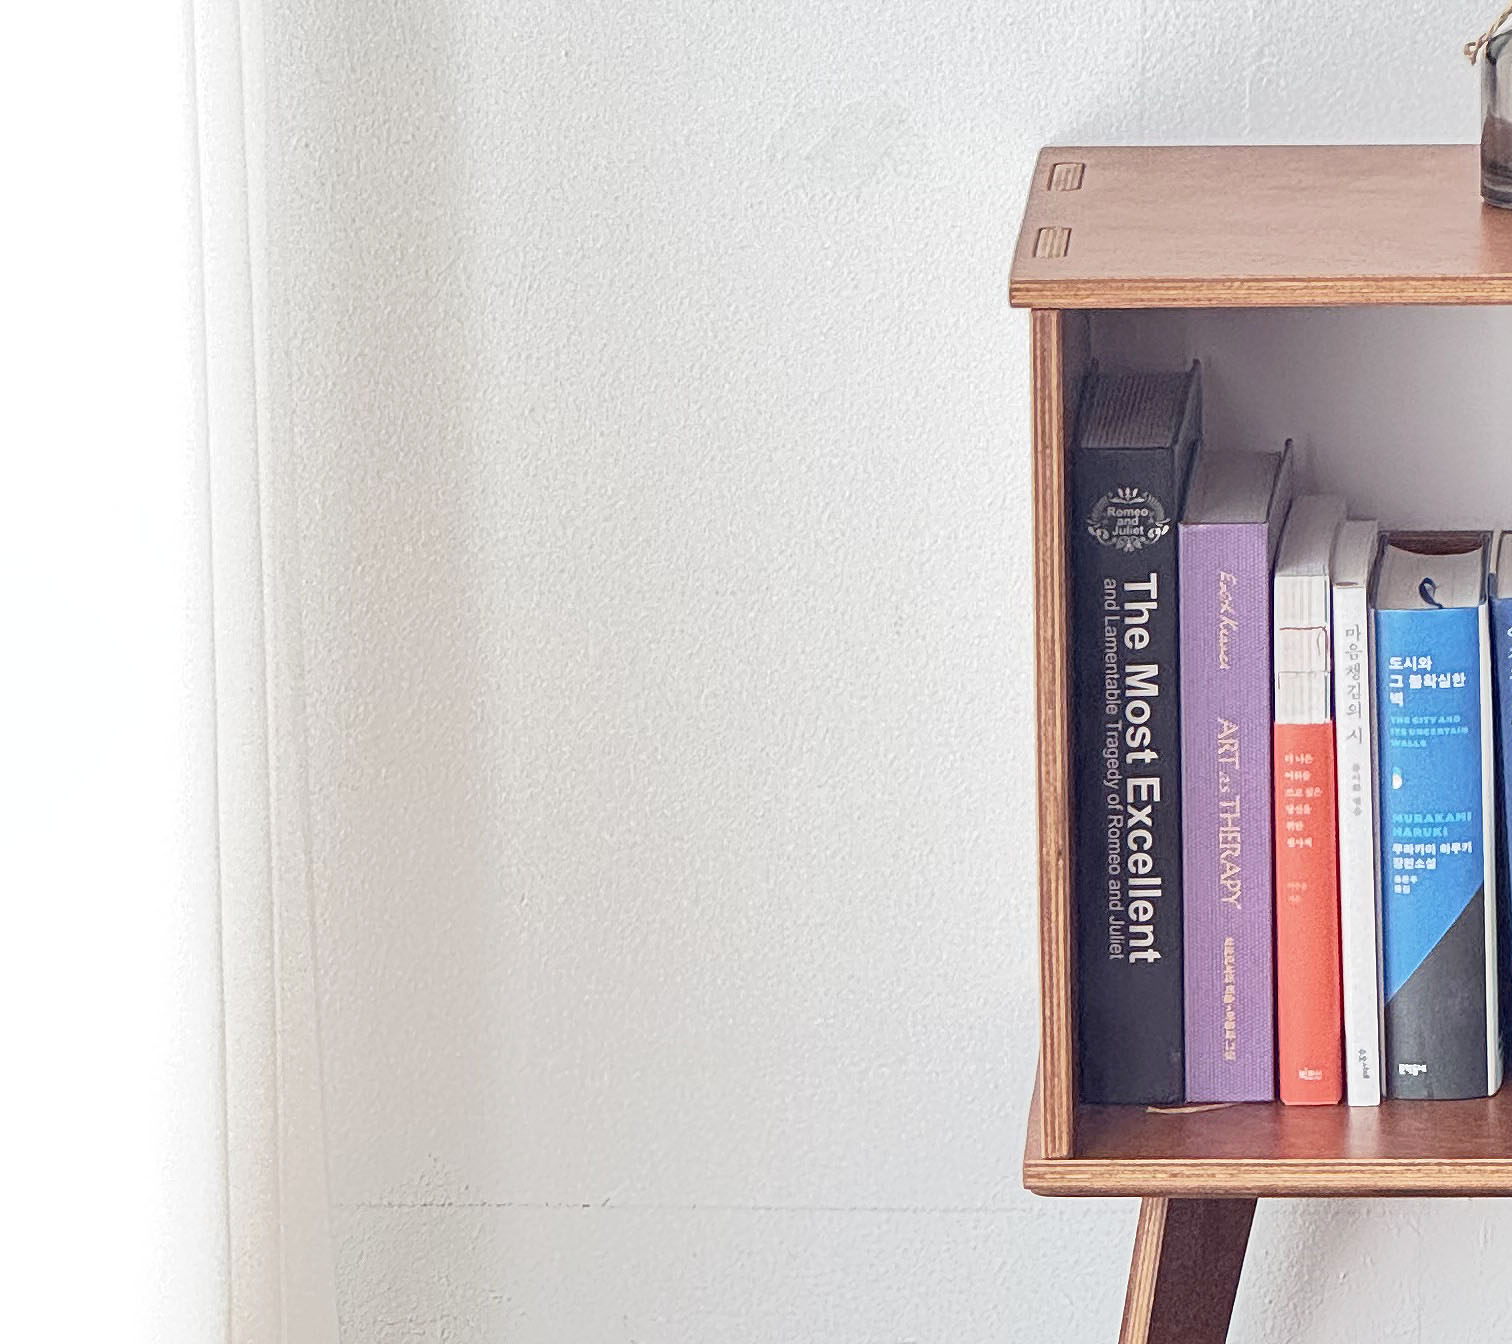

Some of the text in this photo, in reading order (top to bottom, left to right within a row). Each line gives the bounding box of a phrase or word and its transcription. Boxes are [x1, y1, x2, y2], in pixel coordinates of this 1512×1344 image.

[1107, 507, 1149, 518] Romeo
[1117, 517, 1139, 526] and
[1112, 525, 1145, 537] Juliet
[1345, 624, 1363, 719] 마음챙김의
[1389, 656, 1433, 672] 도시와
[1389, 672, 1467, 689] 그 불확실한
[1346, 726, 1362, 745] 시
[1103, 578, 1125, 961] and Lamentable Tragedy of Romeo and Juliet
[1123, 572, 1162, 964] The Most Excellent
[1217, 717, 1242, 910] ART as THERAPY
[1392, 811, 1472, 824] MURAKAMI
[1392, 826, 1448, 837] HARUKI
[1392, 841, 1473, 856] 무라카미 하루키
